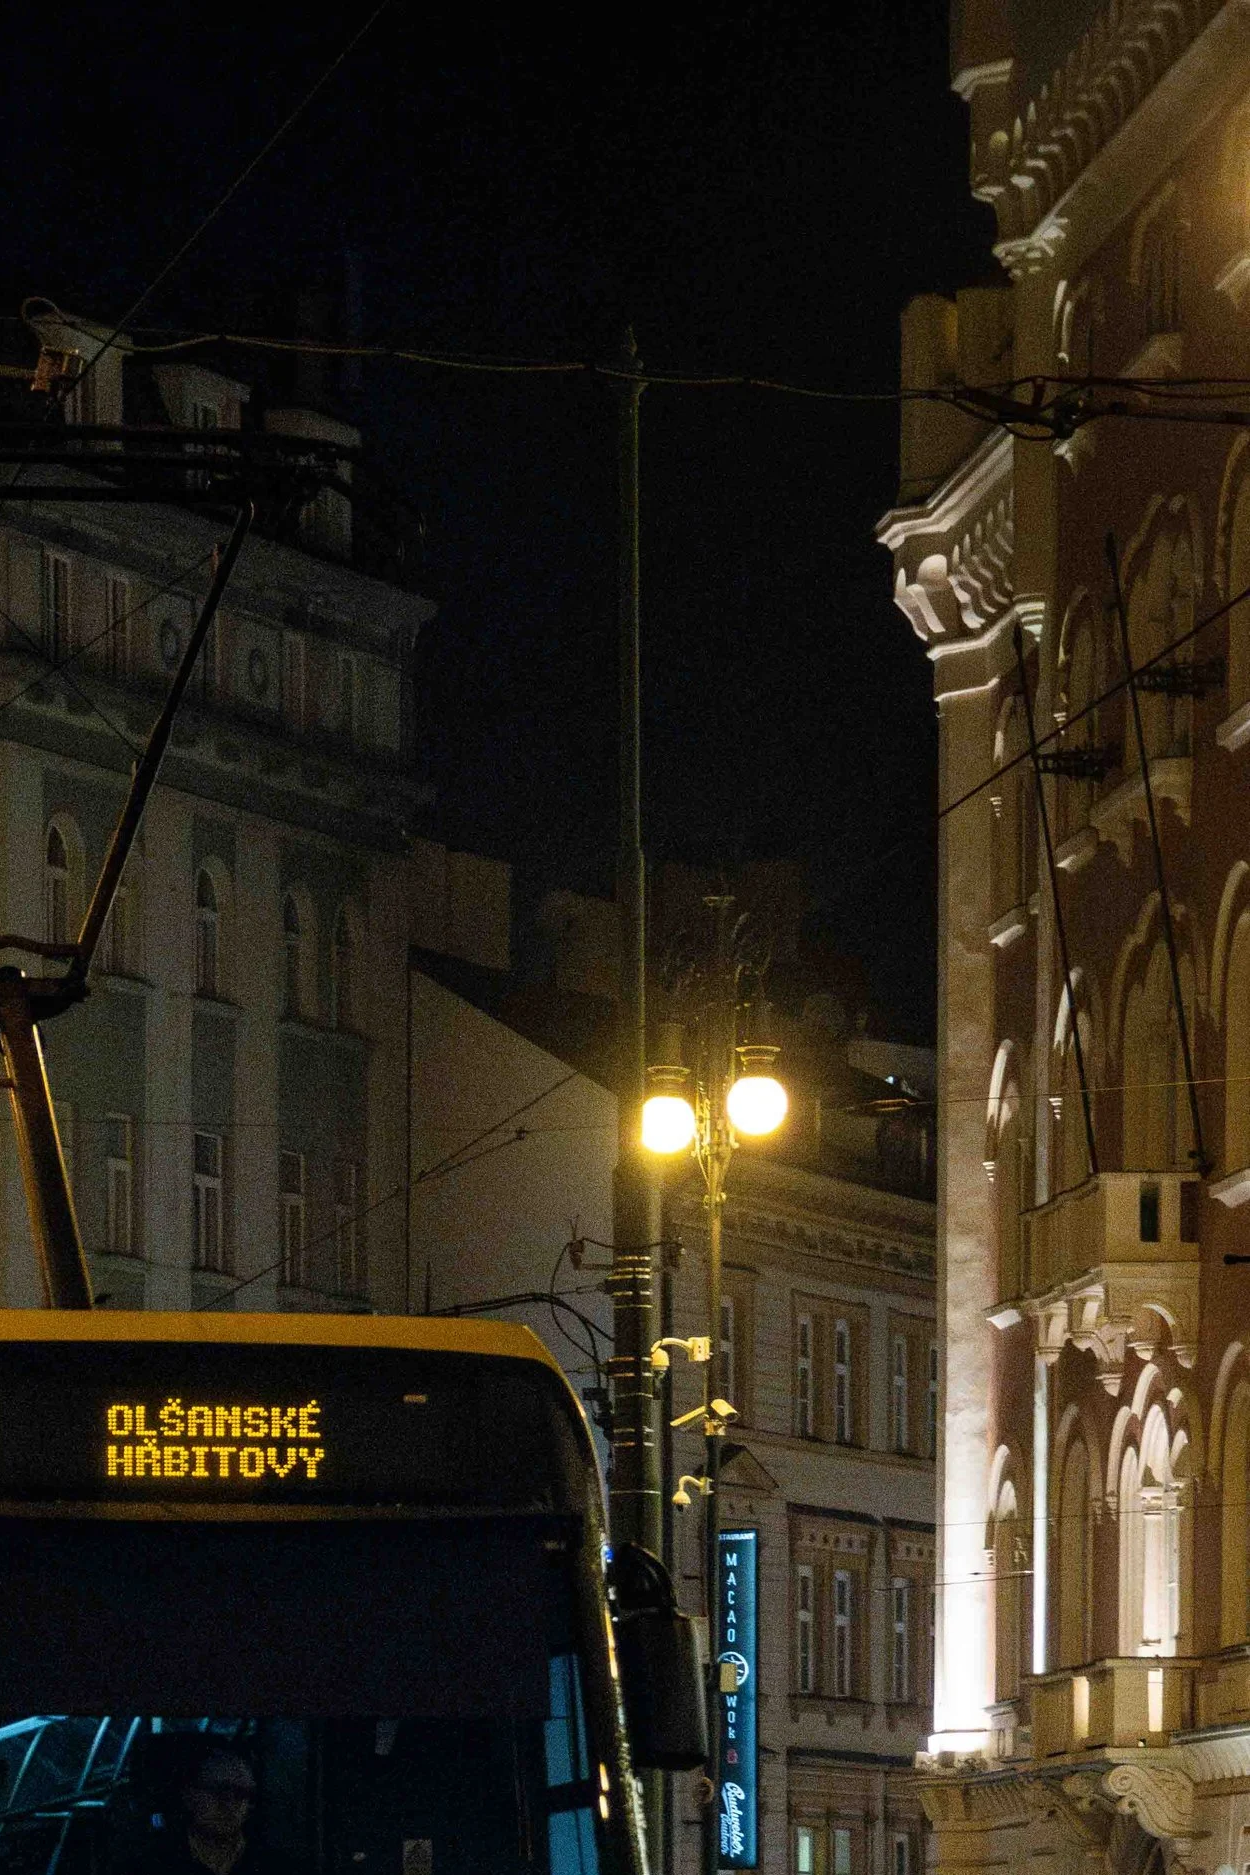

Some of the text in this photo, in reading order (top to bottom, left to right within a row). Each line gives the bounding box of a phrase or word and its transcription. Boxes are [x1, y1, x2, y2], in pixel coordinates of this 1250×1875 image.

[106, 1398, 321, 1438] OLŠANSKÉ
[106, 1437, 325, 1479] HŘBITOVY
[725, 1552, 738, 1643] MACAO
